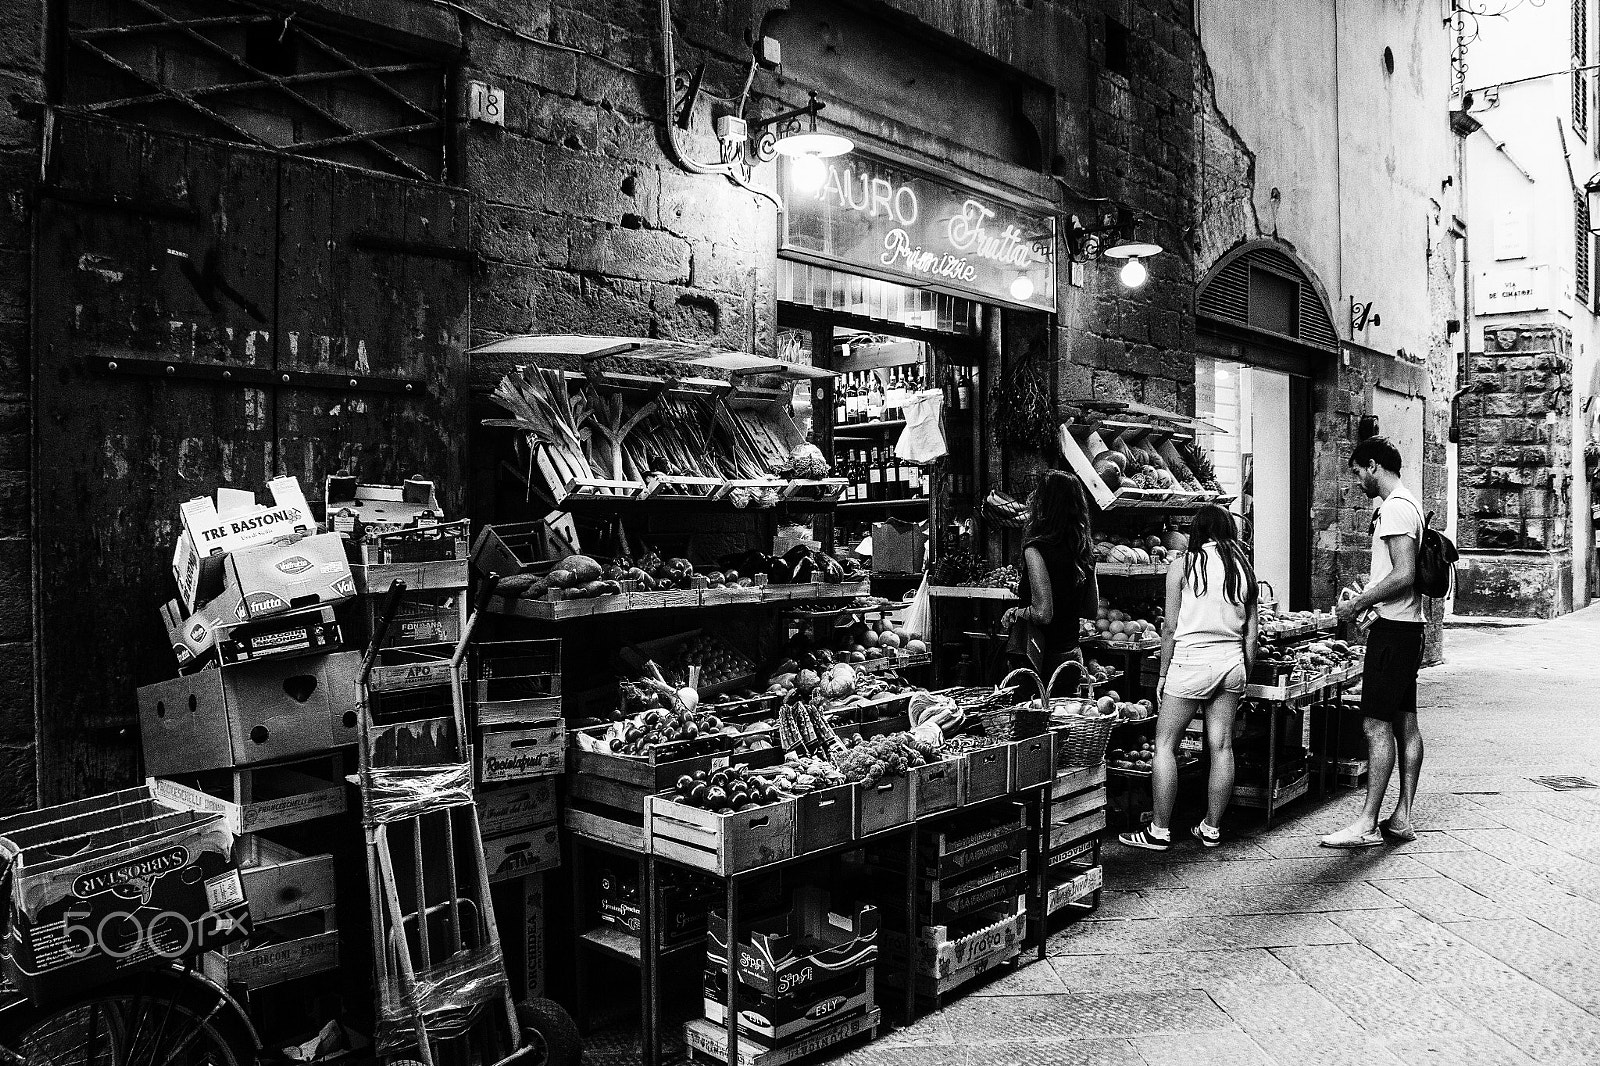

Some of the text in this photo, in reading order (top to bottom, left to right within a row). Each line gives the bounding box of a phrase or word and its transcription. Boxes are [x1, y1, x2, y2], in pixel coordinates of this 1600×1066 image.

[478, 91, 499, 116] 18
[814, 163, 919, 226] AURO
[949, 199, 1031, 267] Frutta
[880, 228, 978, 282] Primizie
[201, 510, 289, 541] TRE BASTONI
[337, 580, 354, 593] Val
[251, 599, 282, 613] frutta
[83, 851, 183, 893] SABROSTAR
[527, 913, 538, 990] ORCHIDEA
[815, 999, 838, 1017] ESLY
